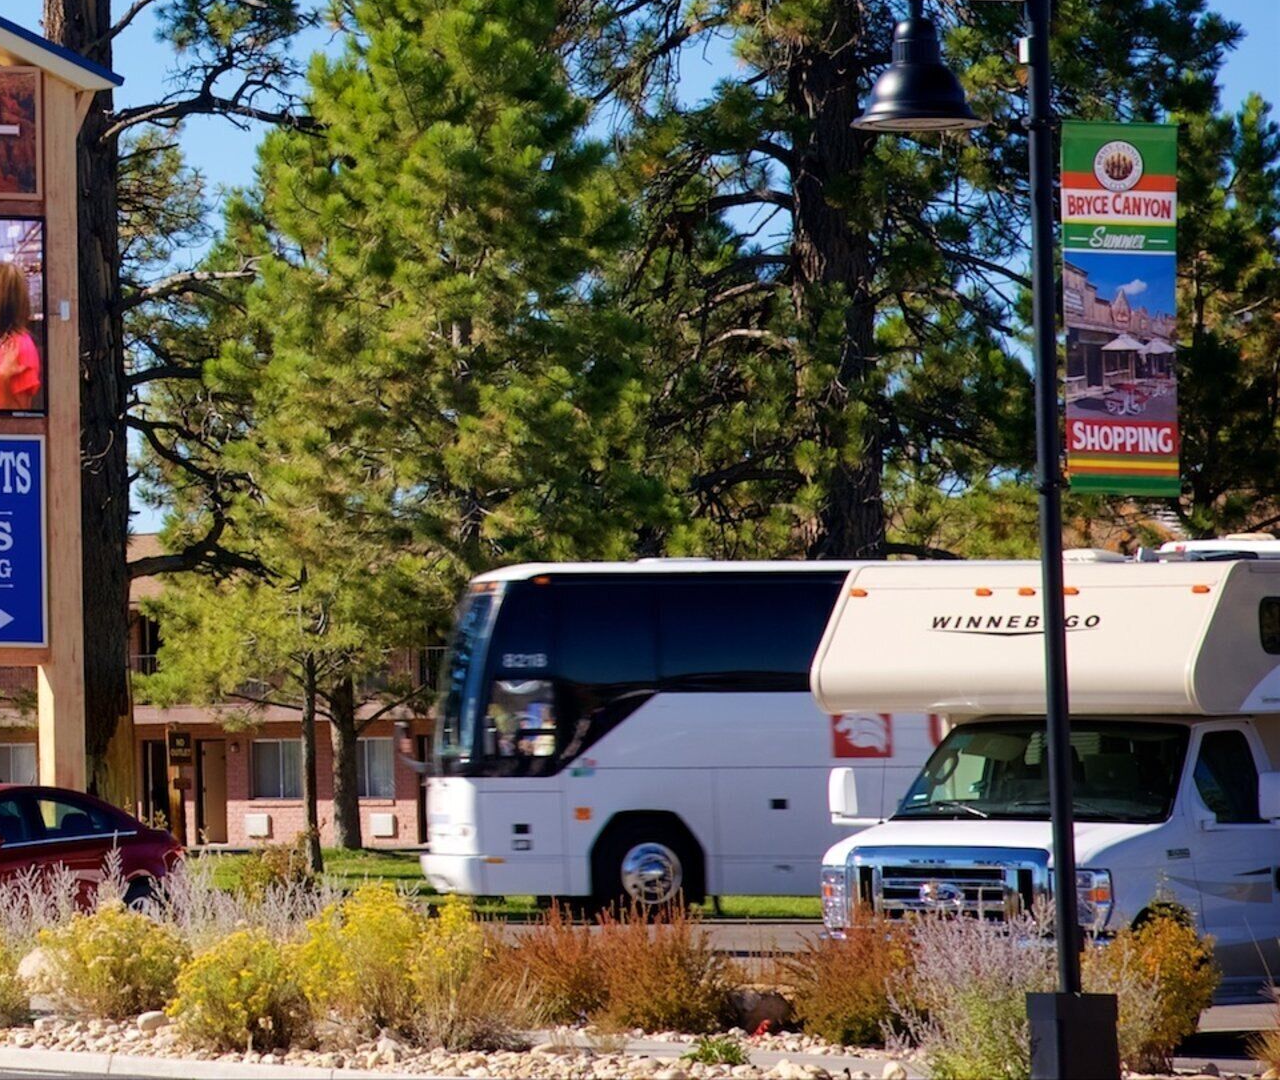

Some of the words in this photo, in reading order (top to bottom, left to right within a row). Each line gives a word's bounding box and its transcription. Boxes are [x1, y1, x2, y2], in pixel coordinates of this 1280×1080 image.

[1067, 193, 1108, 216] BRYCE
[1111, 192, 1172, 219] CANYON
[1089, 226, 1146, 250] Summer
[1072, 421, 1174, 454] SHOPPING
[931, 615, 1101, 629] WINNEBGO
